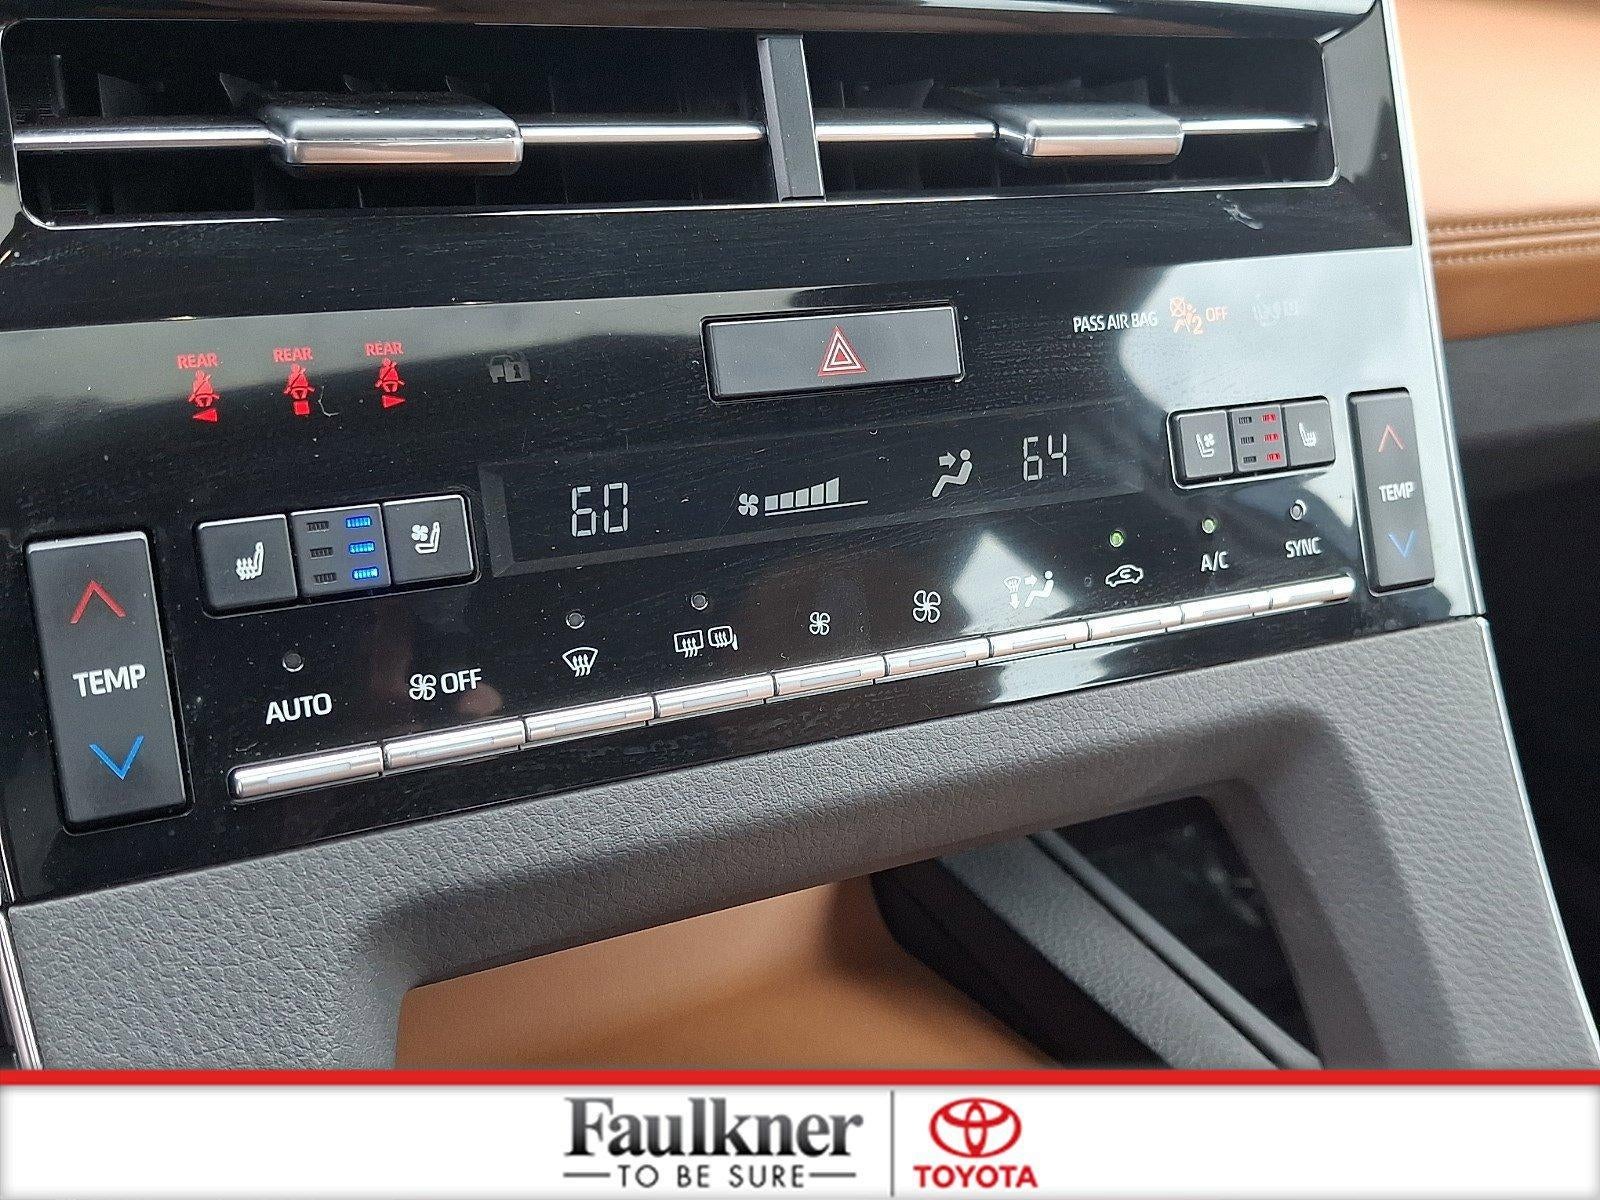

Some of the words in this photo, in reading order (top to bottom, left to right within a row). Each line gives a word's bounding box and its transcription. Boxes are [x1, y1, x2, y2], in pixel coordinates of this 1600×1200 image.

[1073, 314, 1106, 333] PASS
[1108, 313, 1129, 330] AIR
[1131, 310, 1158, 328] BAG
[1204, 307, 1229, 322] OFF
[272, 346, 314, 363] REAR
[363, 341, 405, 357] REAR
[175, 353, 219, 369] REAR
[1022, 433, 1068, 482] 64
[1378, 481, 1416, 502] TEMP
[571, 482, 630, 538] 60
[1284, 537, 1323, 559] SYNC
[1200, 551, 1230, 573] A/C
[72, 663, 147, 698] TEMP
[440, 667, 483, 695] OFF
[264, 692, 334, 725] AUTO
